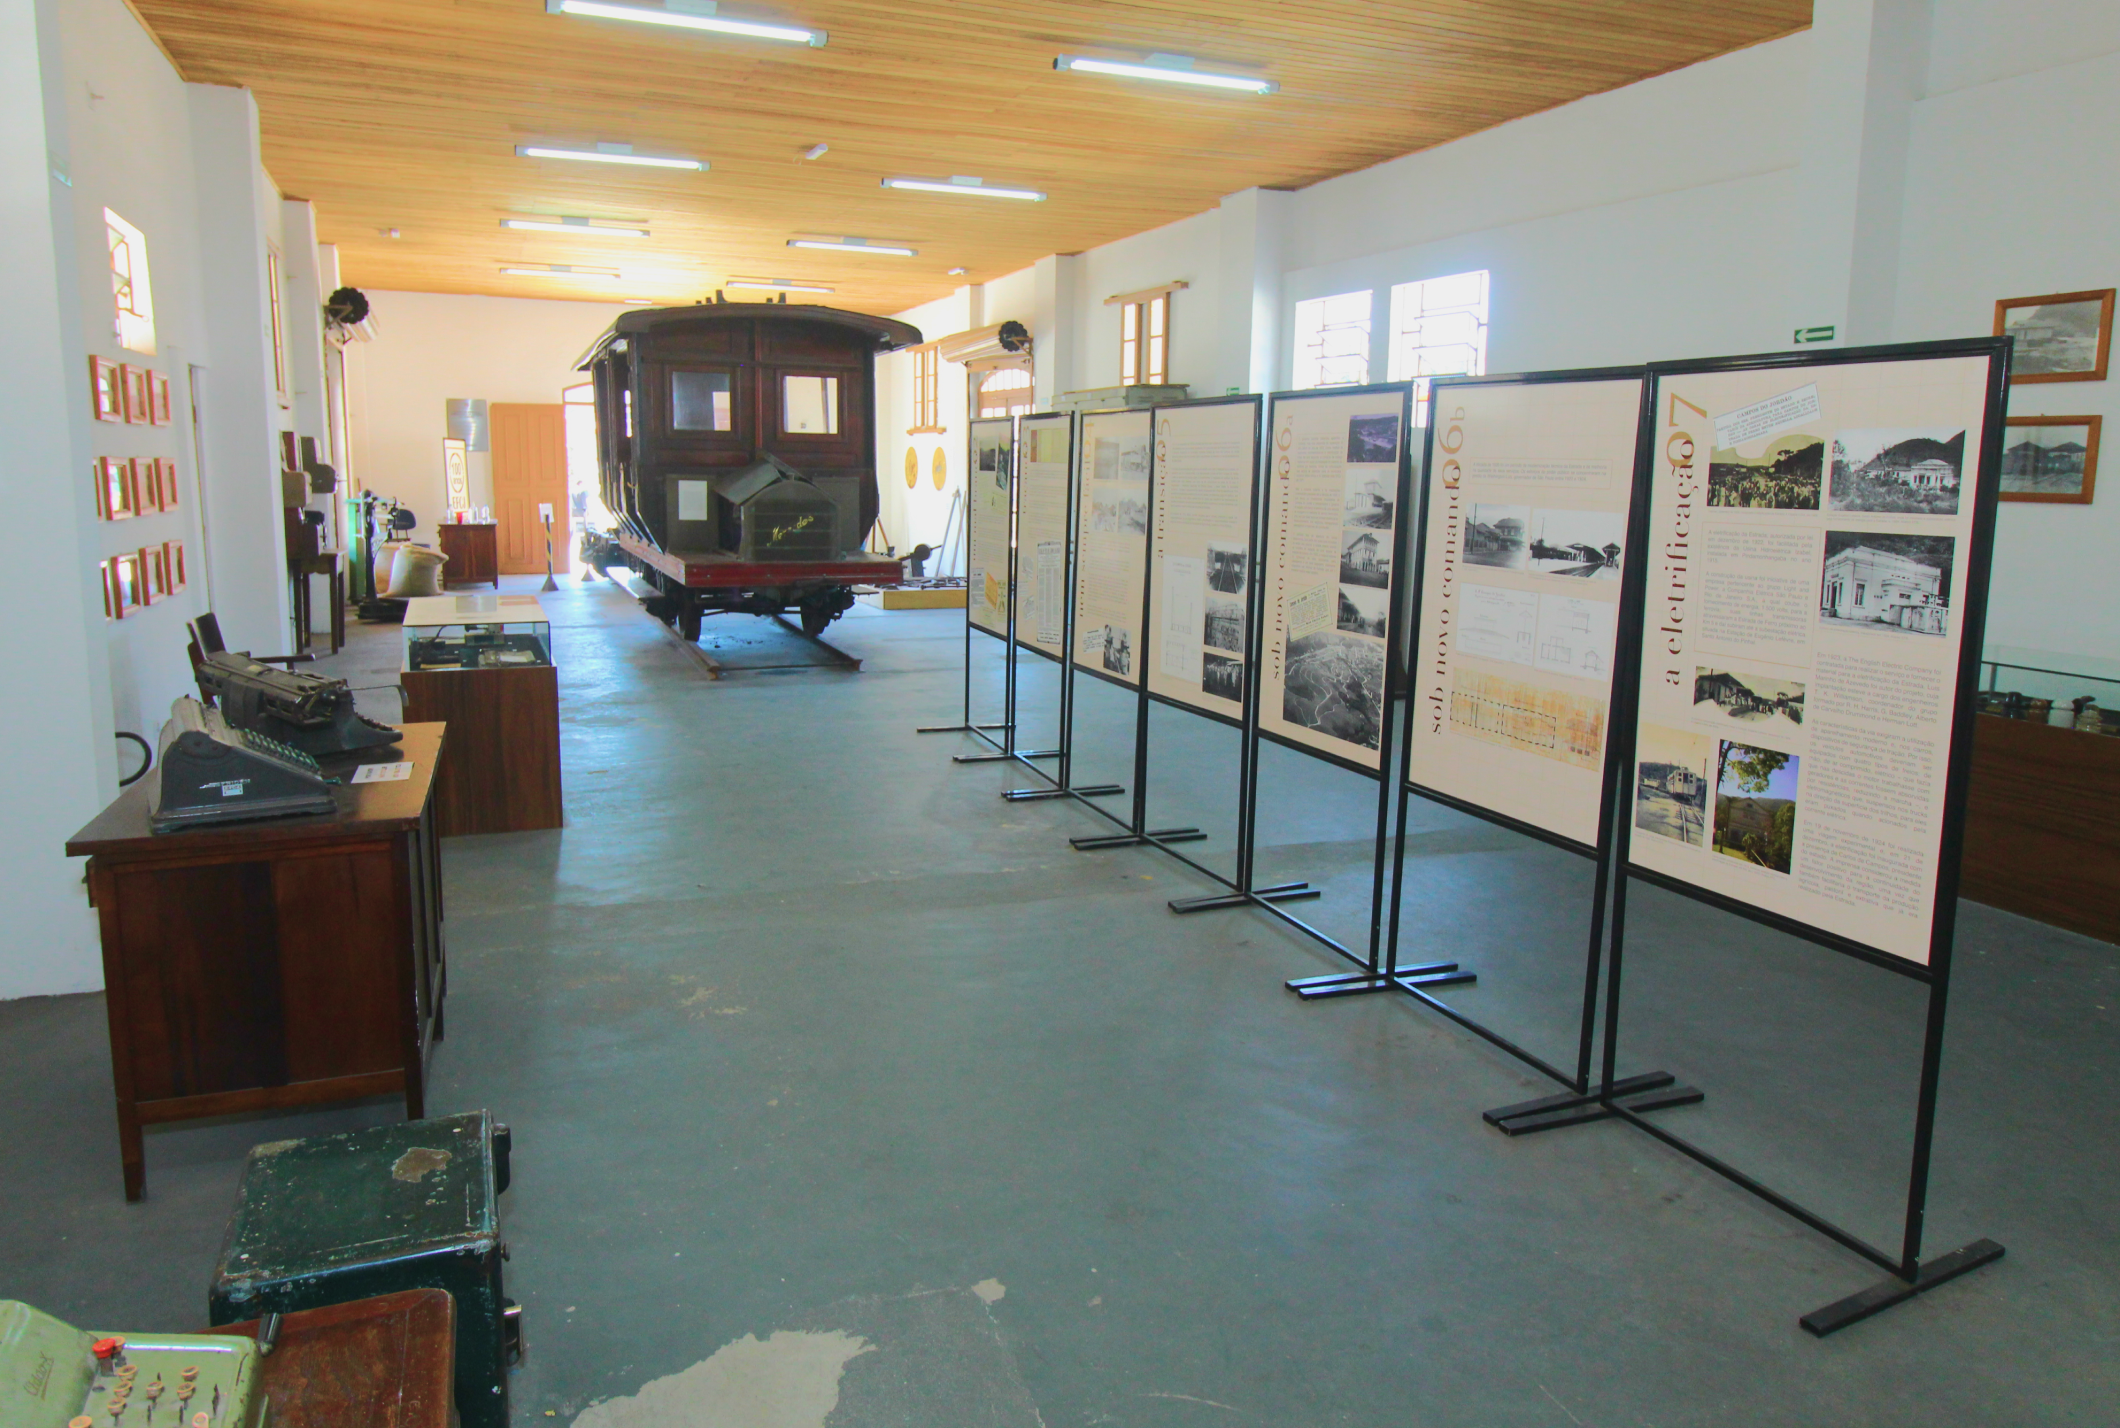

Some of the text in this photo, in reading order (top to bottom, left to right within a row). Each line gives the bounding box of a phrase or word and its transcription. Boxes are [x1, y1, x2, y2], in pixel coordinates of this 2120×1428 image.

[1156, 418, 1171, 461] 05
[1666, 392, 1707, 467] 07
[1736, 395, 1792, 419] CAMPOS DO JORDÃO
[451, 462, 461, 475] 100
[1272, 459, 1291, 680] sob novo comando
[1428, 464, 1461, 735] sob novo comando
[1660, 438, 1699, 686] a eletrificação
